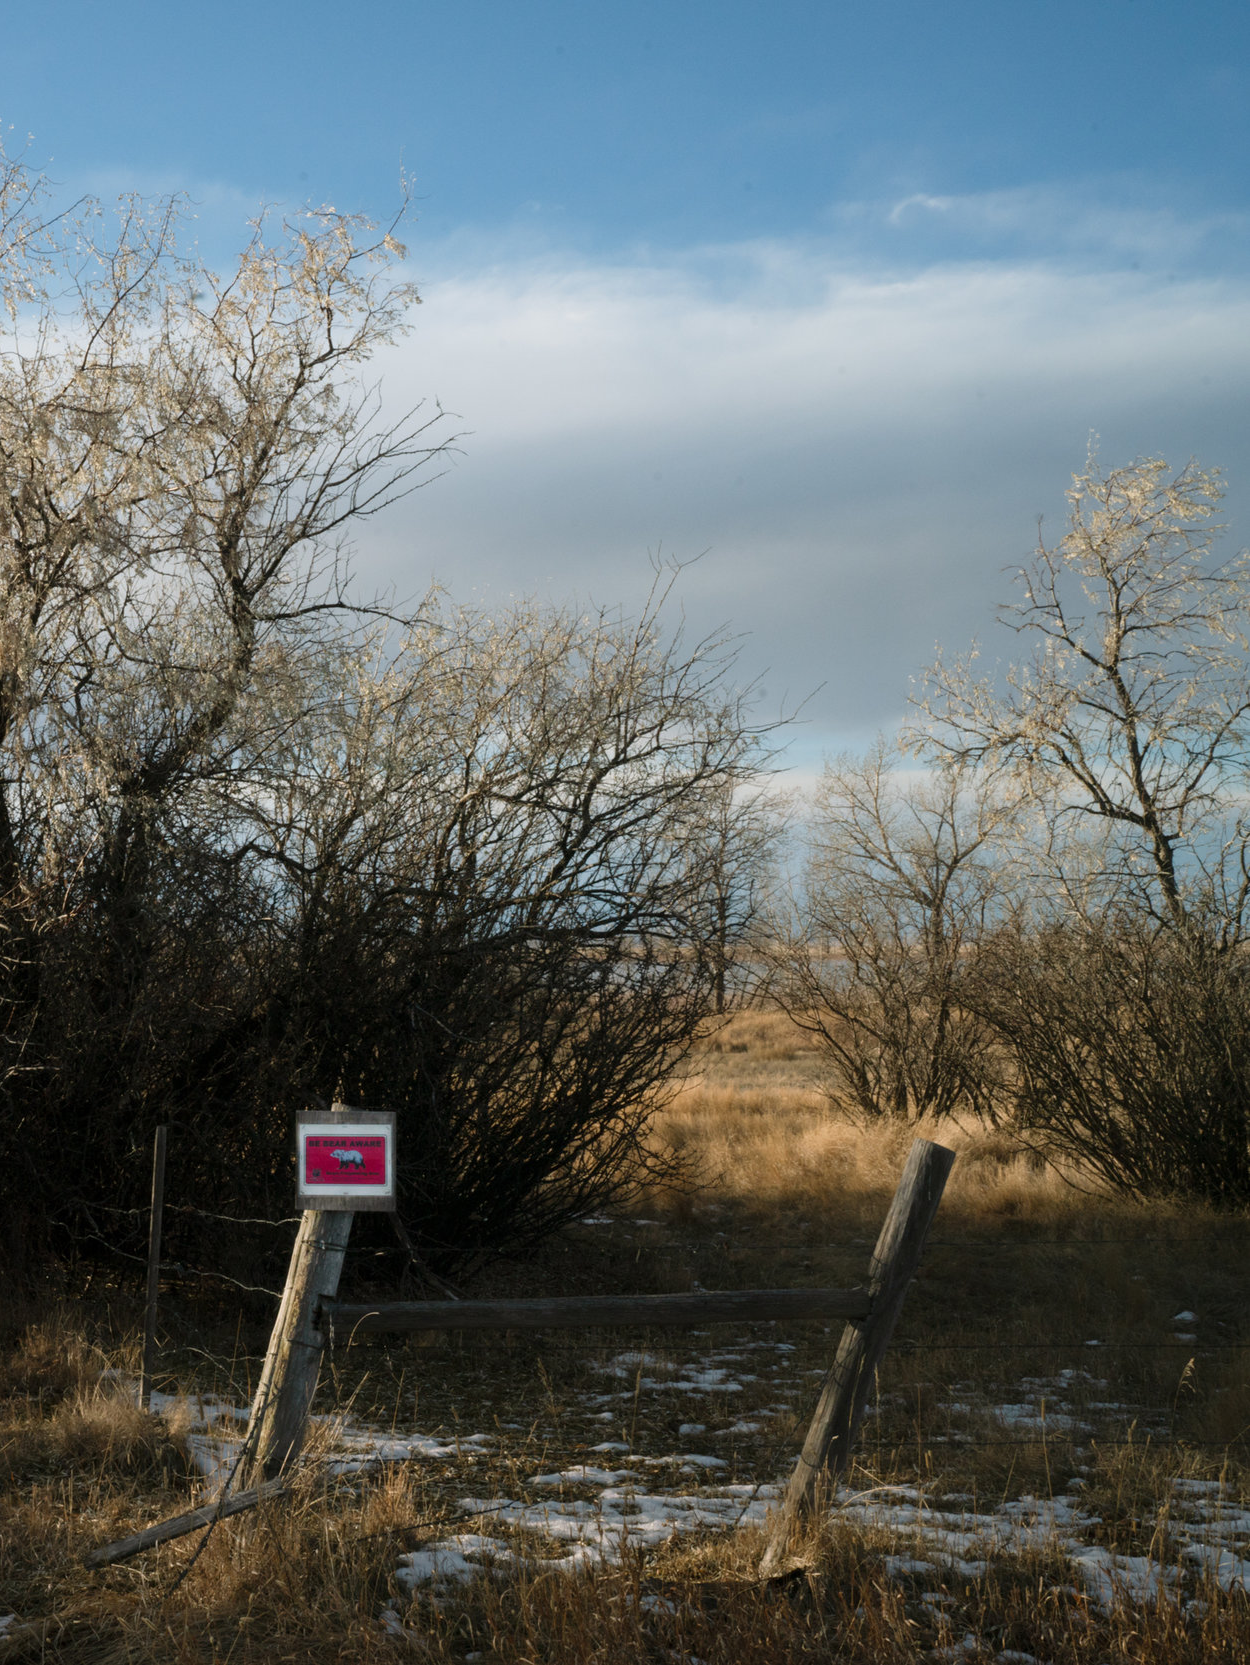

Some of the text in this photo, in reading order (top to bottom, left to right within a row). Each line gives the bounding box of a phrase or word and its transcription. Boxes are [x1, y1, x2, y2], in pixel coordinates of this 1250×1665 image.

[309, 1140, 382, 1148] BE BEAR AWARE
